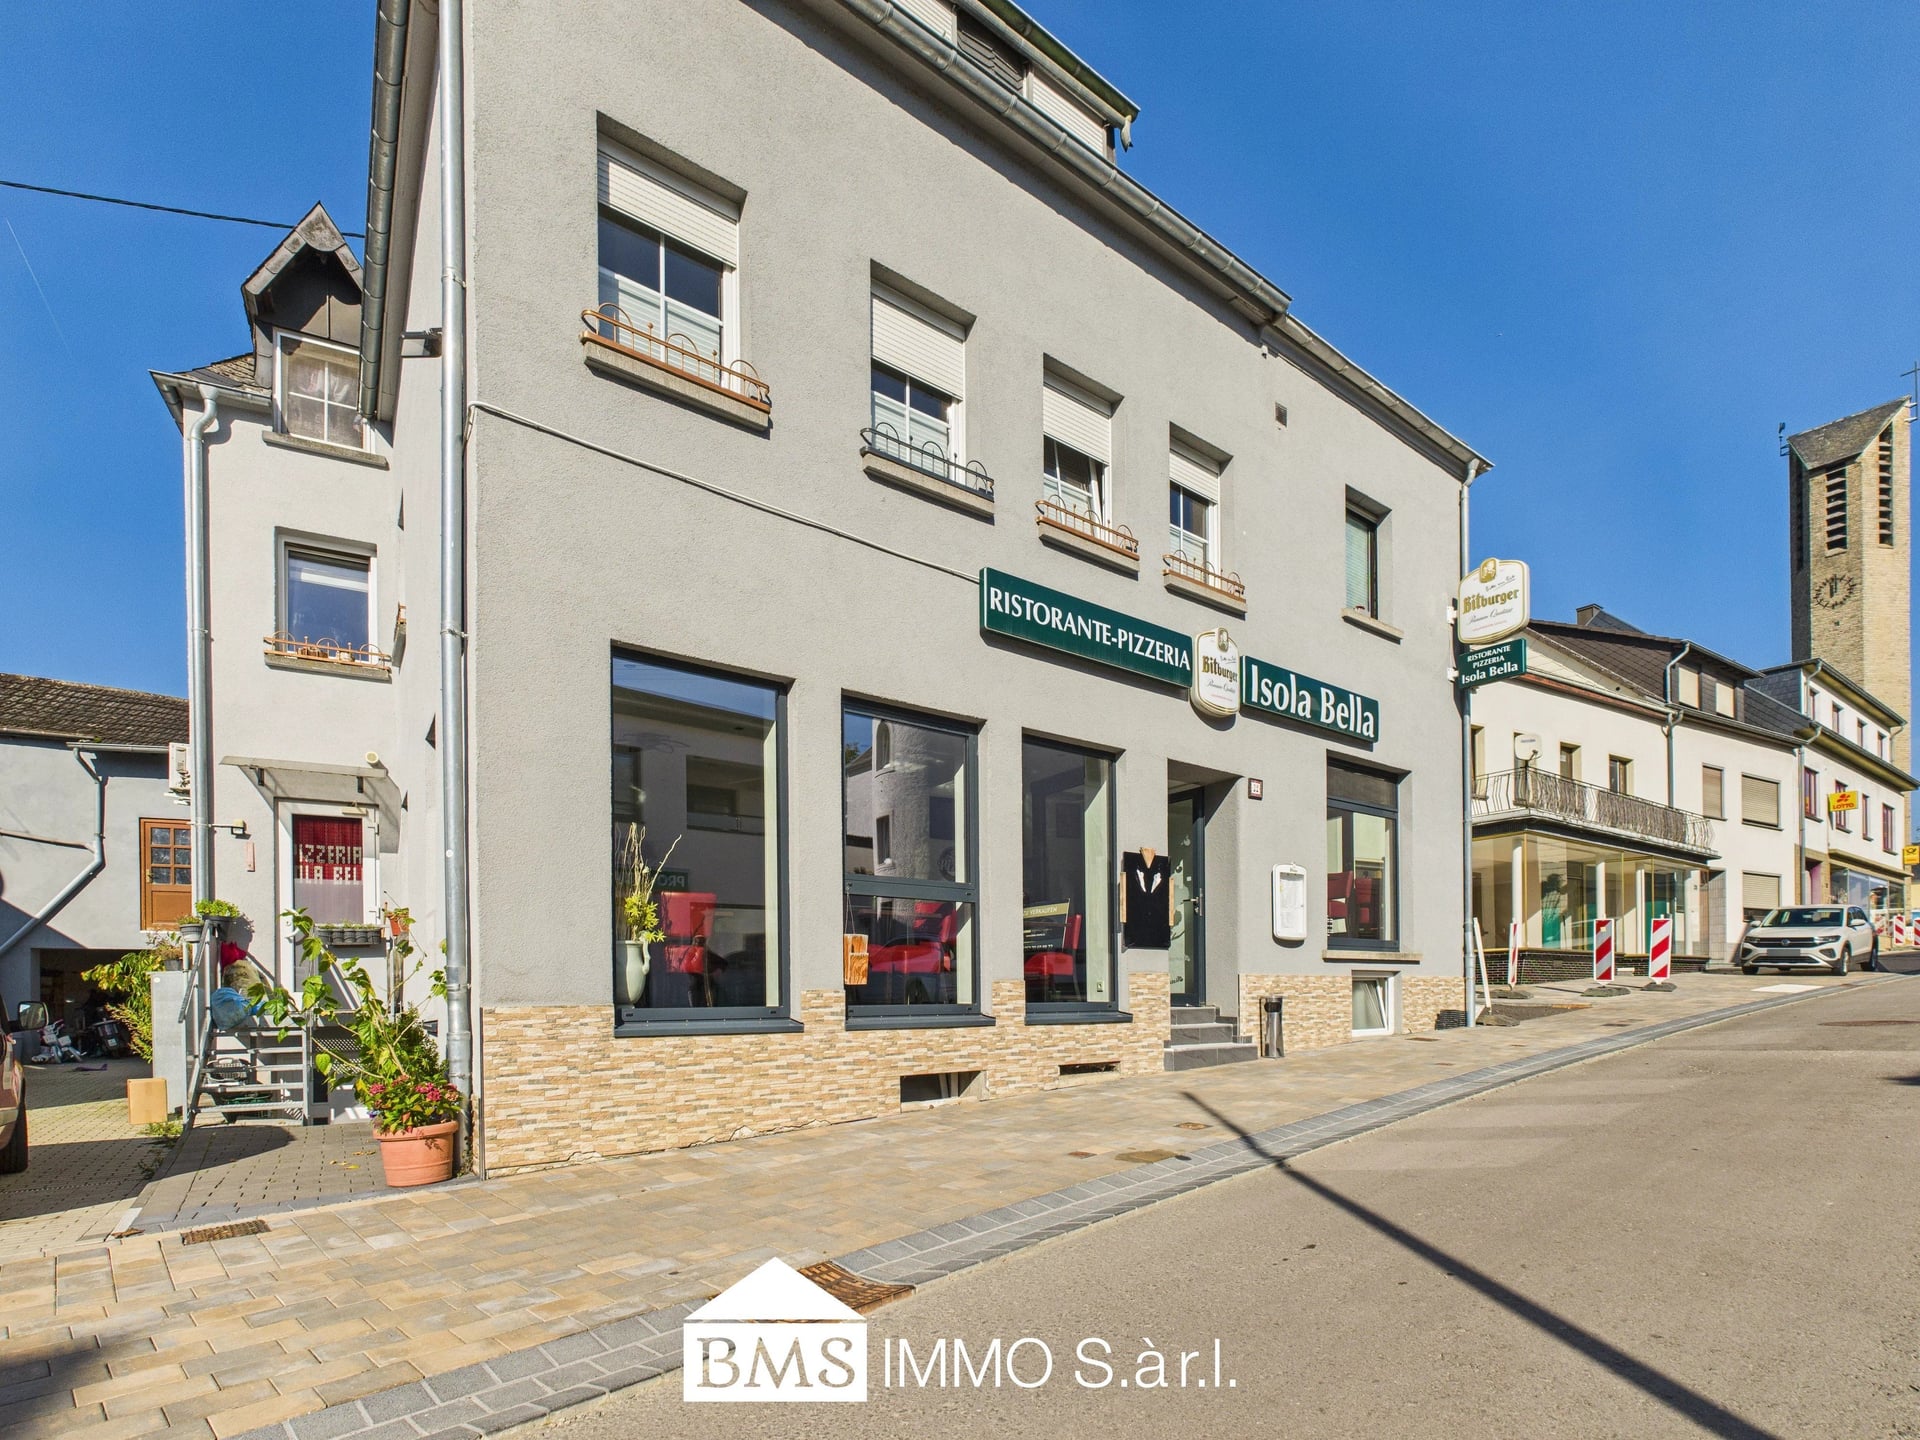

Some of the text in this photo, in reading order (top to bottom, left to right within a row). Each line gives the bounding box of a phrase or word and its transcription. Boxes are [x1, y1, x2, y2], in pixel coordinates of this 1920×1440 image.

[1463, 590, 1520, 614] Bitburger
[989, 586, 1191, 671] RISTORANTE-PIZZERIA
[1467, 645, 1511, 661] RISTORANTE
[1472, 654, 1505, 669] PIZZERIA
[1201, 655, 1238, 683] Bitburger
[1462, 661, 1518, 684] Isola Bella
[1251, 663, 1375, 738] Isola Bella
[1832, 802, 1855, 810] LOTTO
